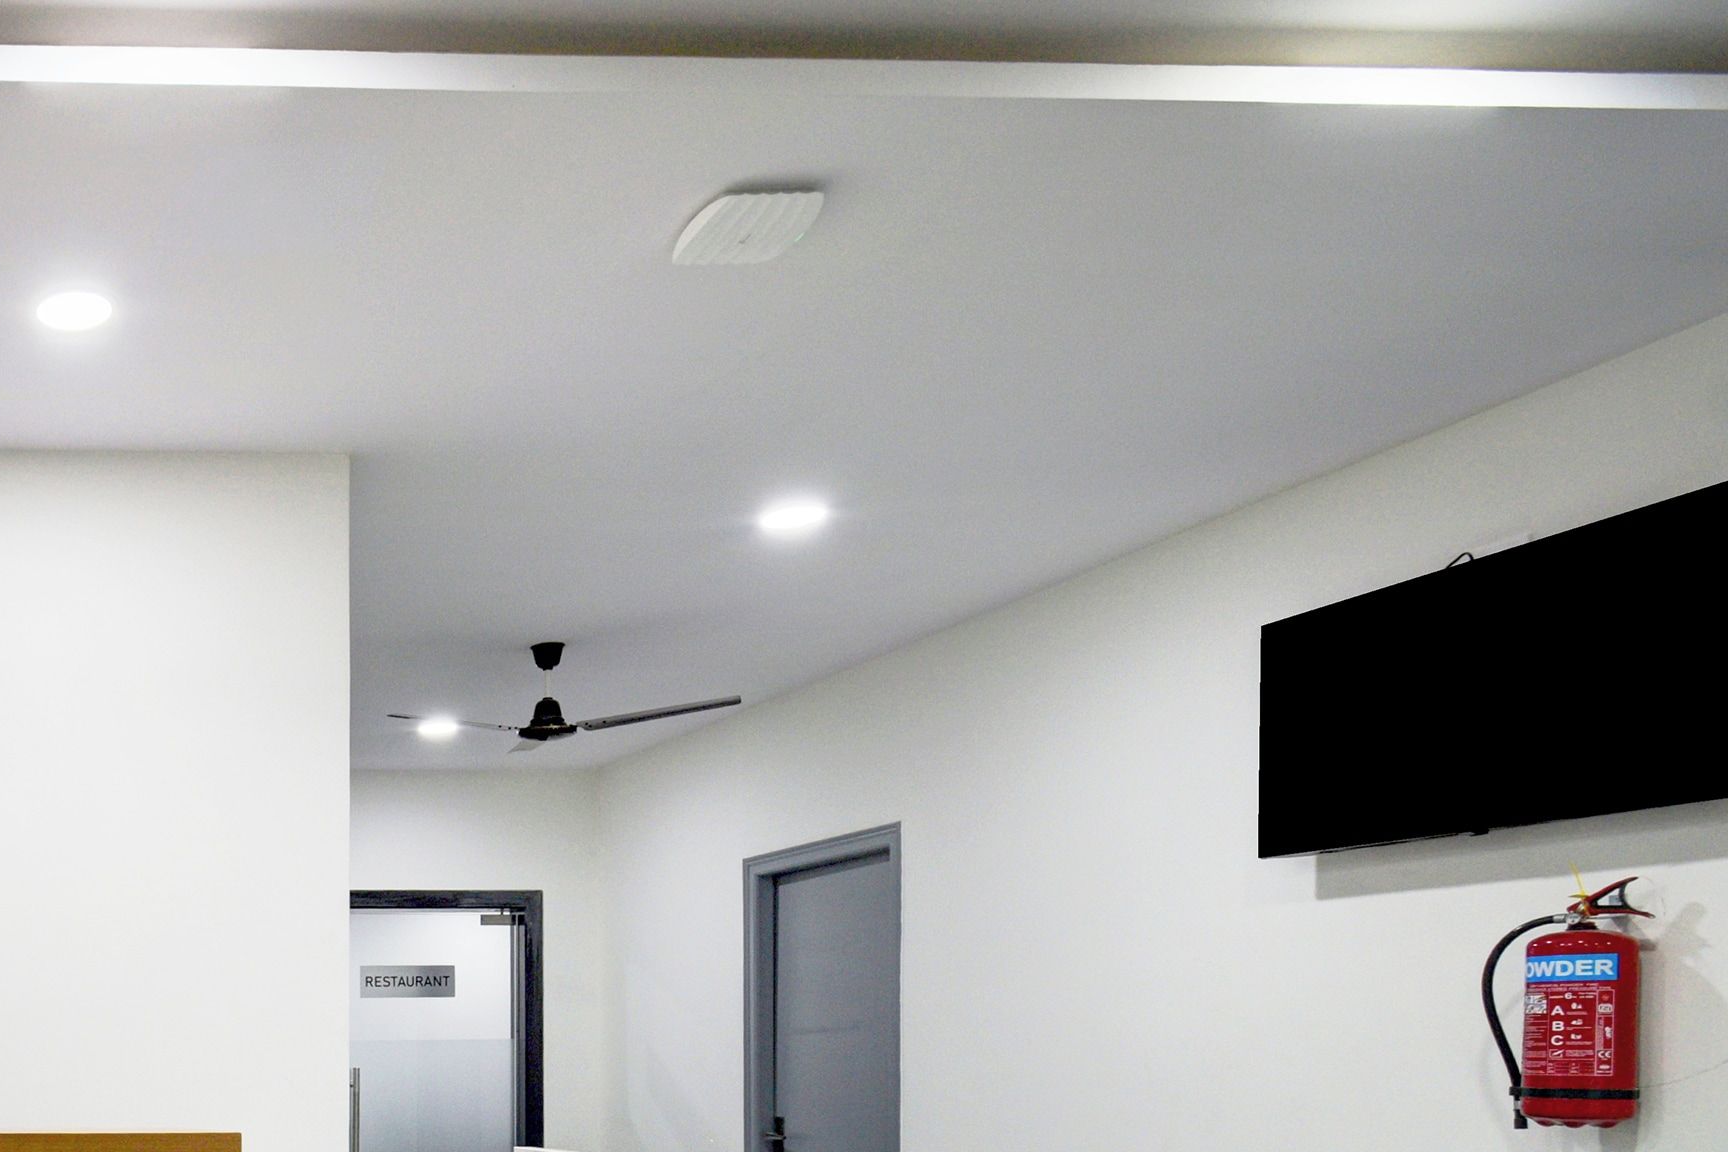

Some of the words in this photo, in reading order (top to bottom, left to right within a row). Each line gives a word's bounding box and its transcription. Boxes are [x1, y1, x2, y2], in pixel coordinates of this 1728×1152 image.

[365, 976, 450, 988] RESTAURANT
[1551, 1005, 1565, 1016] A
[1552, 1020, 1565, 1031] B
[1551, 1035, 1564, 1046] C
